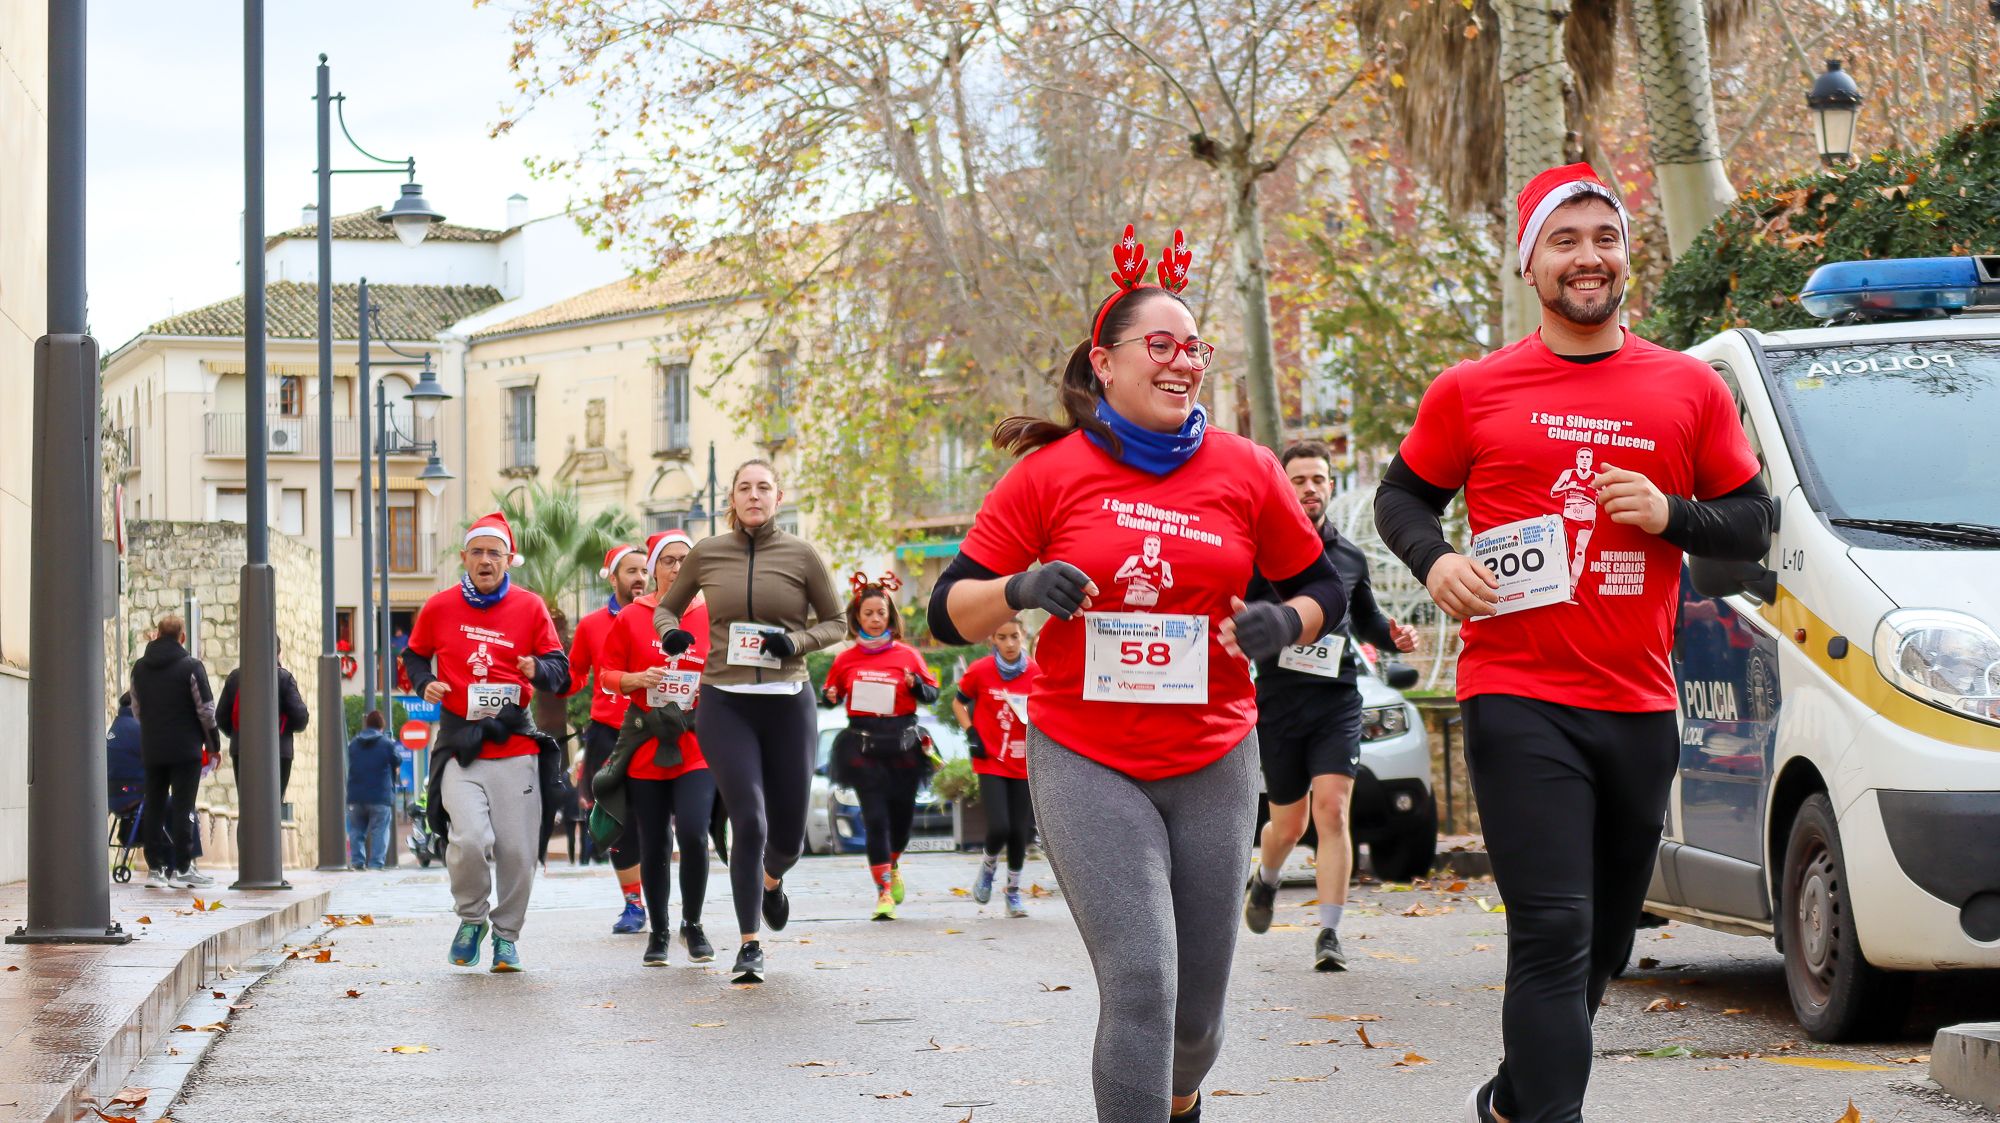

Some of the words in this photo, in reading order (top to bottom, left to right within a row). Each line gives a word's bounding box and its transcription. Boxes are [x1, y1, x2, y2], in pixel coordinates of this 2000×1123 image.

[1530, 412, 1539, 424] I
[1540, 413, 1564, 427] San
[1566, 414, 1622, 432] Silvestre
[1548, 426, 1592, 443] Ciudad
[1594, 431, 1610, 445] de
[1611, 433, 1656, 451] Lucena
[1102, 498, 1111, 510] I
[1111, 499, 1135, 514] San
[1135, 502, 1190, 525] Silvestre
[1116, 513, 1161, 533] Ciudad
[1161, 522, 1178, 536] de
[1180, 525, 1223, 547] Lucena
[1600, 550, 1646, 562] MEMORIAL
[1782, 549, 1804, 572] L-10
[1484, 548, 1545, 580] 200
[1590, 561, 1612, 573] JOSE
[1613, 562, 1646, 573] CARLOS
[1605, 573, 1645, 585] HURTADO
[1530, 583, 1559, 594] enerplus
[1598, 584, 1644, 596] MARJALIZO
[740, 636, 766, 649] 12
[1120, 641, 1171, 667] 58
[1294, 645, 1328, 658] 378
[657, 682, 690, 695] 356
[1162, 683, 1194, 691] enerplus
[479, 696, 512, 707] 500
[1684, 681, 1739, 721] POLICIA
[1683, 727, 1704, 746] LOCAL
